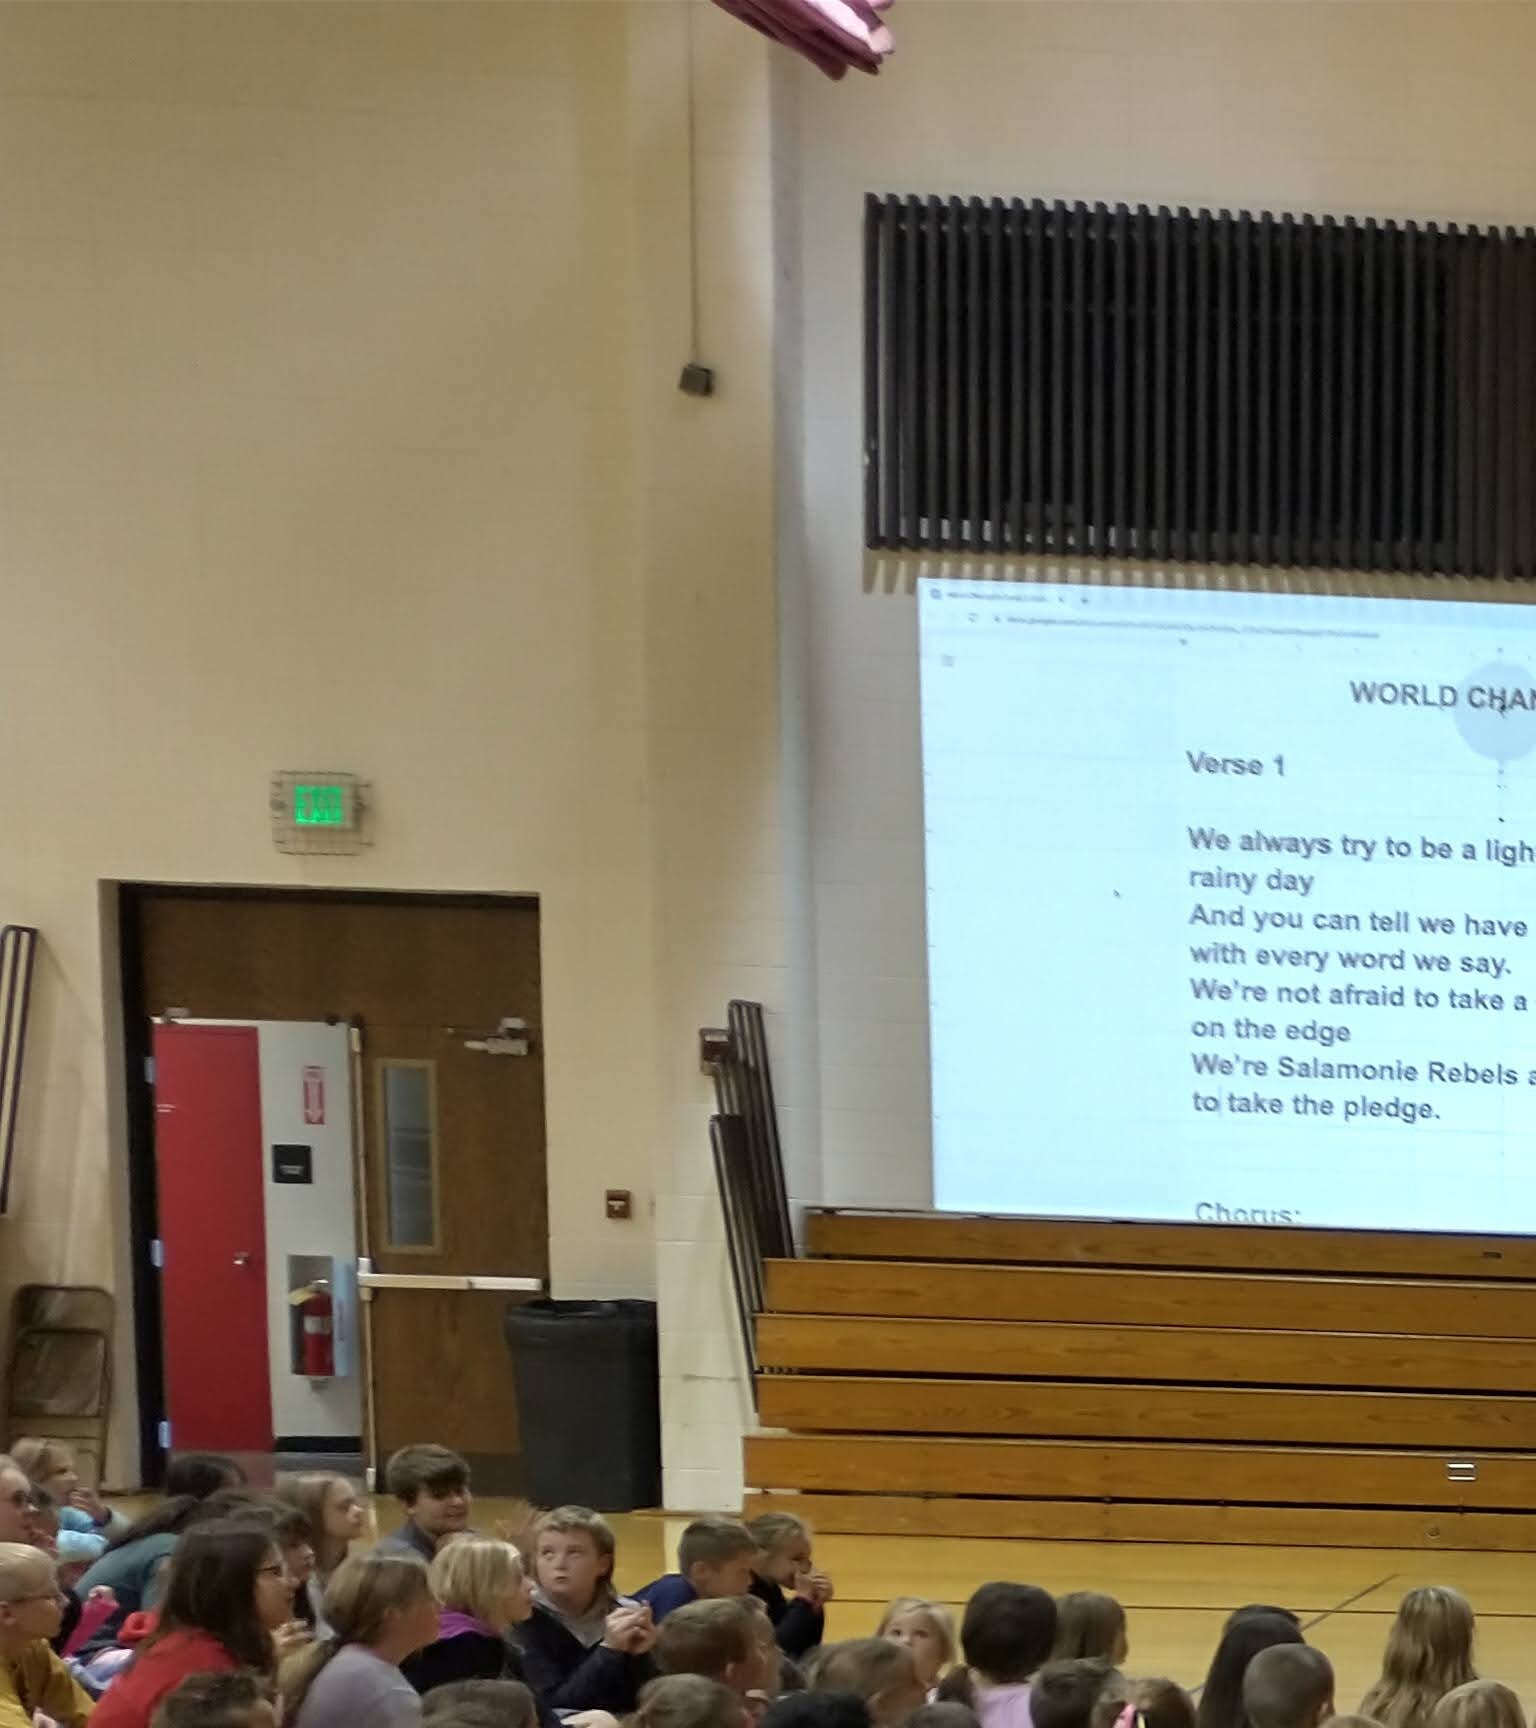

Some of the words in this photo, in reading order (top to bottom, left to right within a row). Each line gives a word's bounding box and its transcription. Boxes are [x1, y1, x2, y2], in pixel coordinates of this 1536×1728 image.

[1349, 681, 1459, 711] WORLD
[1185, 750, 1264, 777] Verse
[1273, 754, 1284, 777] 1
[1187, 826, 1232, 851] We
[1239, 829, 1333, 860] always
[1340, 834, 1378, 863] try
[1385, 836, 1412, 858] to
[1420, 836, 1454, 860] be
[1461, 843, 1477, 861] a
[1189, 865, 1258, 896] rainy
[1266, 868, 1315, 897] day
[1188, 903, 1245, 927] And
[1253, 910, 1303, 934] you
[1312, 913, 1361, 931] can
[1368, 910, 1410, 933] tell
[1417, 916, 1456, 935] we
[1464, 913, 1528, 938] have
[1189, 941, 1247, 965] with
[1255, 948, 1329, 974] every
[1337, 948, 1406, 971] word
[1412, 953, 1452, 973] we
[1459, 956, 1512, 980] say.
[1189, 977, 1268, 1003] We're
[1277, 983, 1321, 1005] not
[1328, 983, 1405, 1007] afraid
[1413, 988, 1440, 1009] to
[1447, 988, 1505, 1011] take
[1513, 994, 1528, 1012] a
[1191, 1020, 1225, 1039] on
[1233, 1017, 1277, 1040] the
[1285, 1019, 1351, 1048] edge
[1191, 1052, 1269, 1077] We're
[1277, 1055, 1419, 1082] Salamonie
[1428, 1060, 1519, 1086] Rebels
[1192, 1091, 1221, 1112] to
[1227, 1091, 1284, 1115] take
[1291, 1093, 1335, 1116] the
[1343, 1095, 1441, 1125] pledge.
